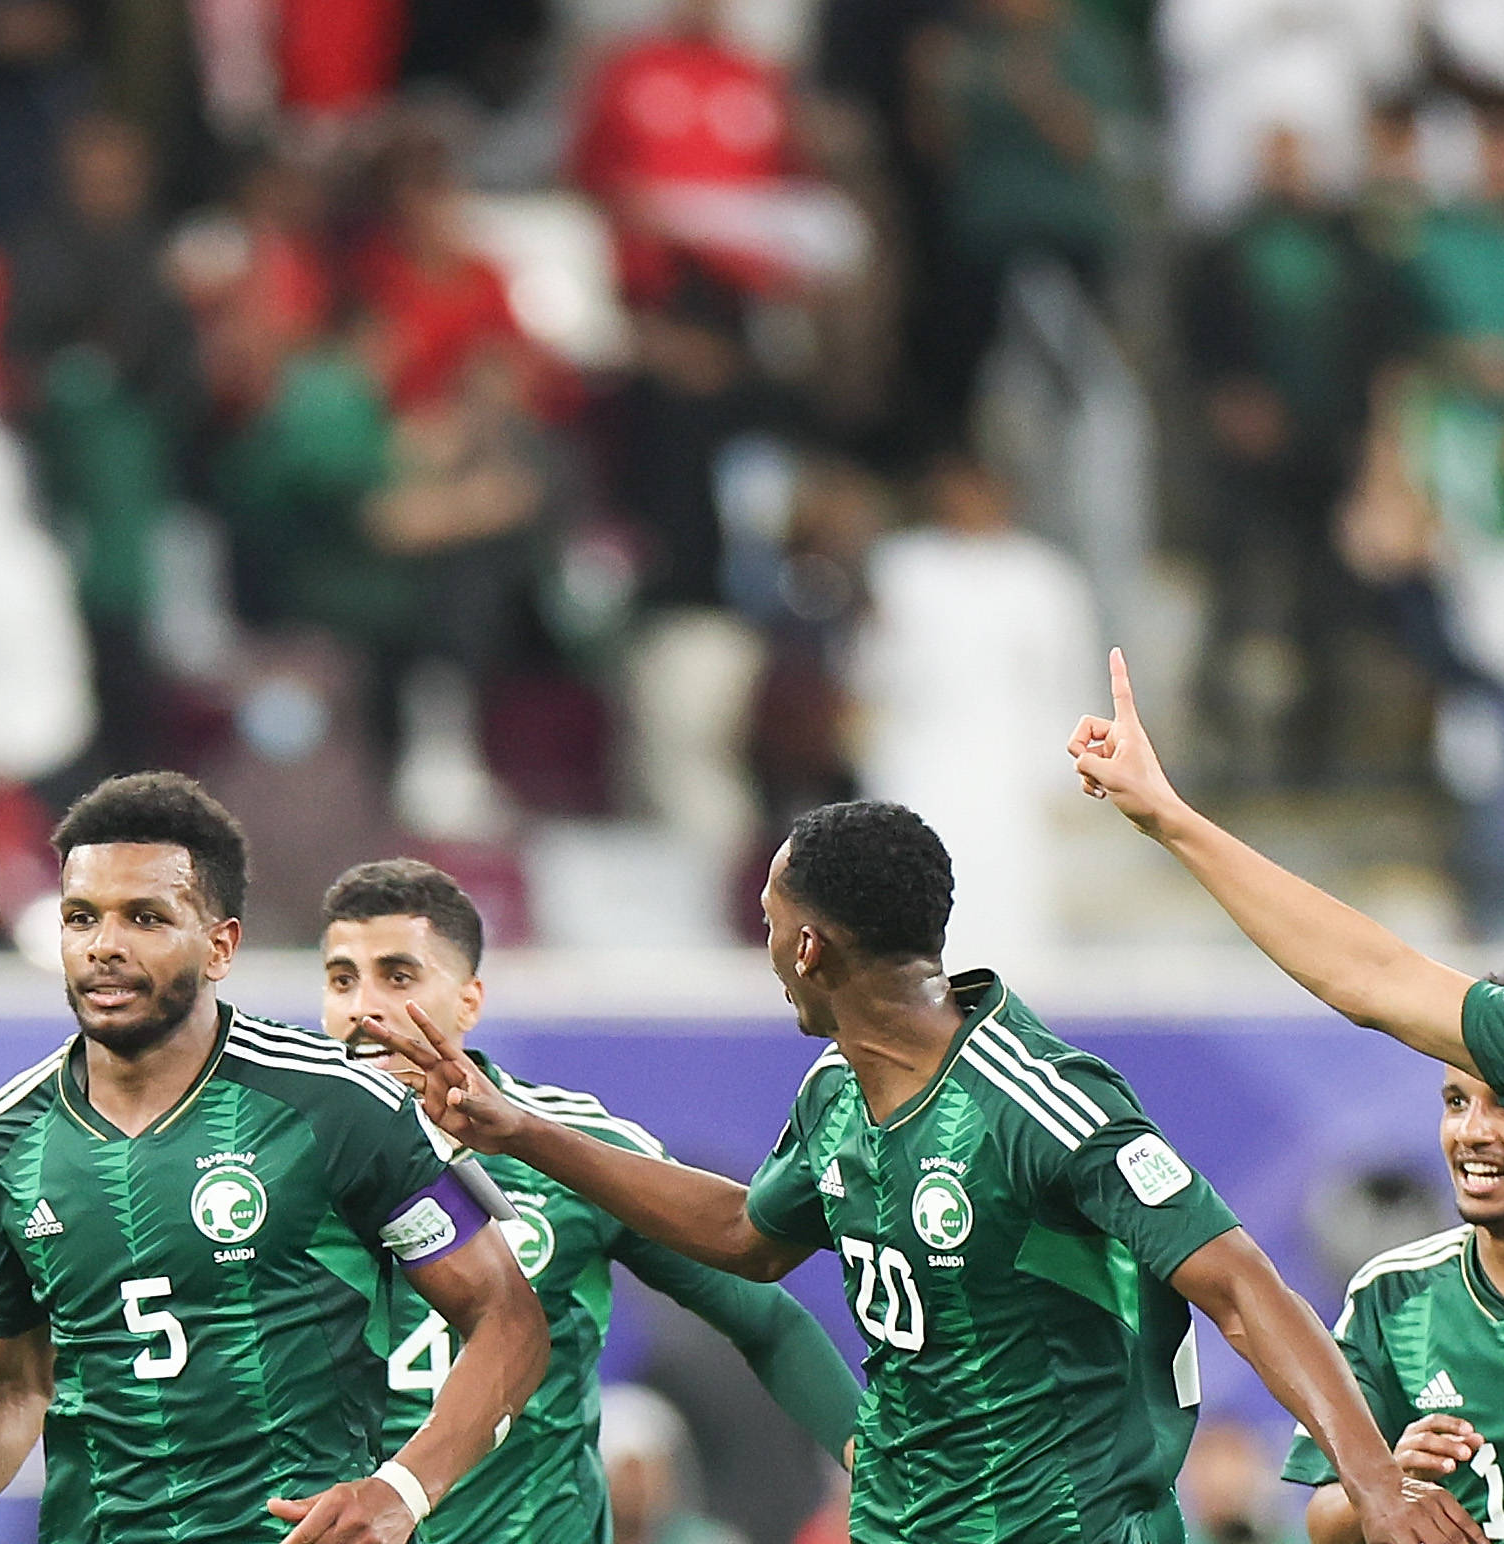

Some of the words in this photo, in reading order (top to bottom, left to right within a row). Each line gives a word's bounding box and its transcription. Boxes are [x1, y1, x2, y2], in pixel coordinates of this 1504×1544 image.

[1128, 1147, 1150, 1166] AFC
[1133, 1151, 1170, 1181] LIVE
[24, 1220, 65, 1240] adidas
[213, 1247, 256, 1264] SAUDI
[927, 1255, 965, 1268] SAUDI
[840, 1235, 925, 1352] 20
[120, 1276, 189, 1380] 5
[387, 1308, 451, 1404] 4
